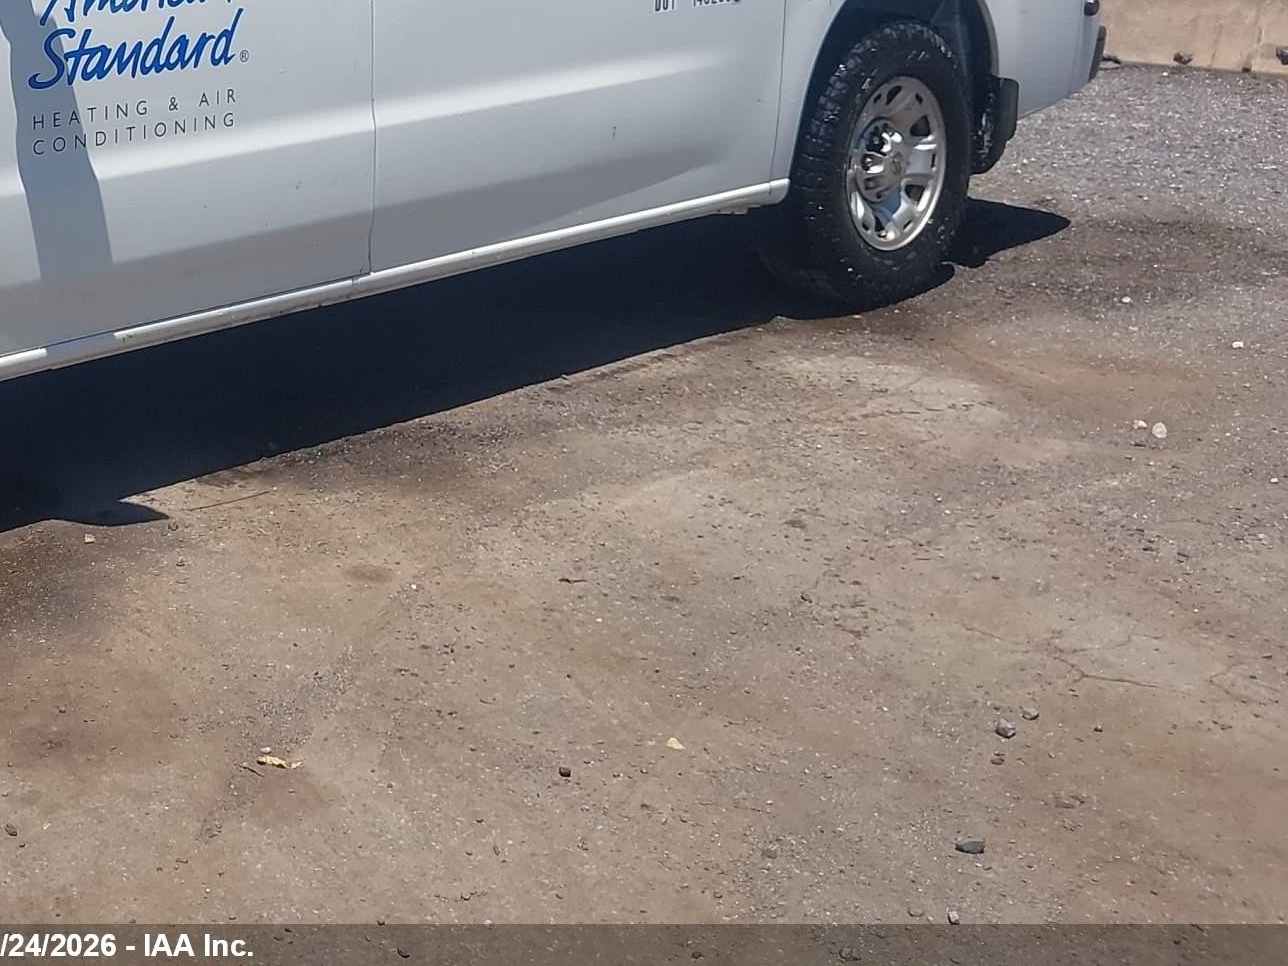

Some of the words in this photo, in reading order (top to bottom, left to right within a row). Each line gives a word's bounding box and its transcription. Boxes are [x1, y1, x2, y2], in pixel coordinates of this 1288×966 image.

[33, 100, 149, 131] HEATING
[169, 96, 179, 111] &
[199, 89, 237, 107] AIR
[33, 113, 235, 155] CONDITIONING
